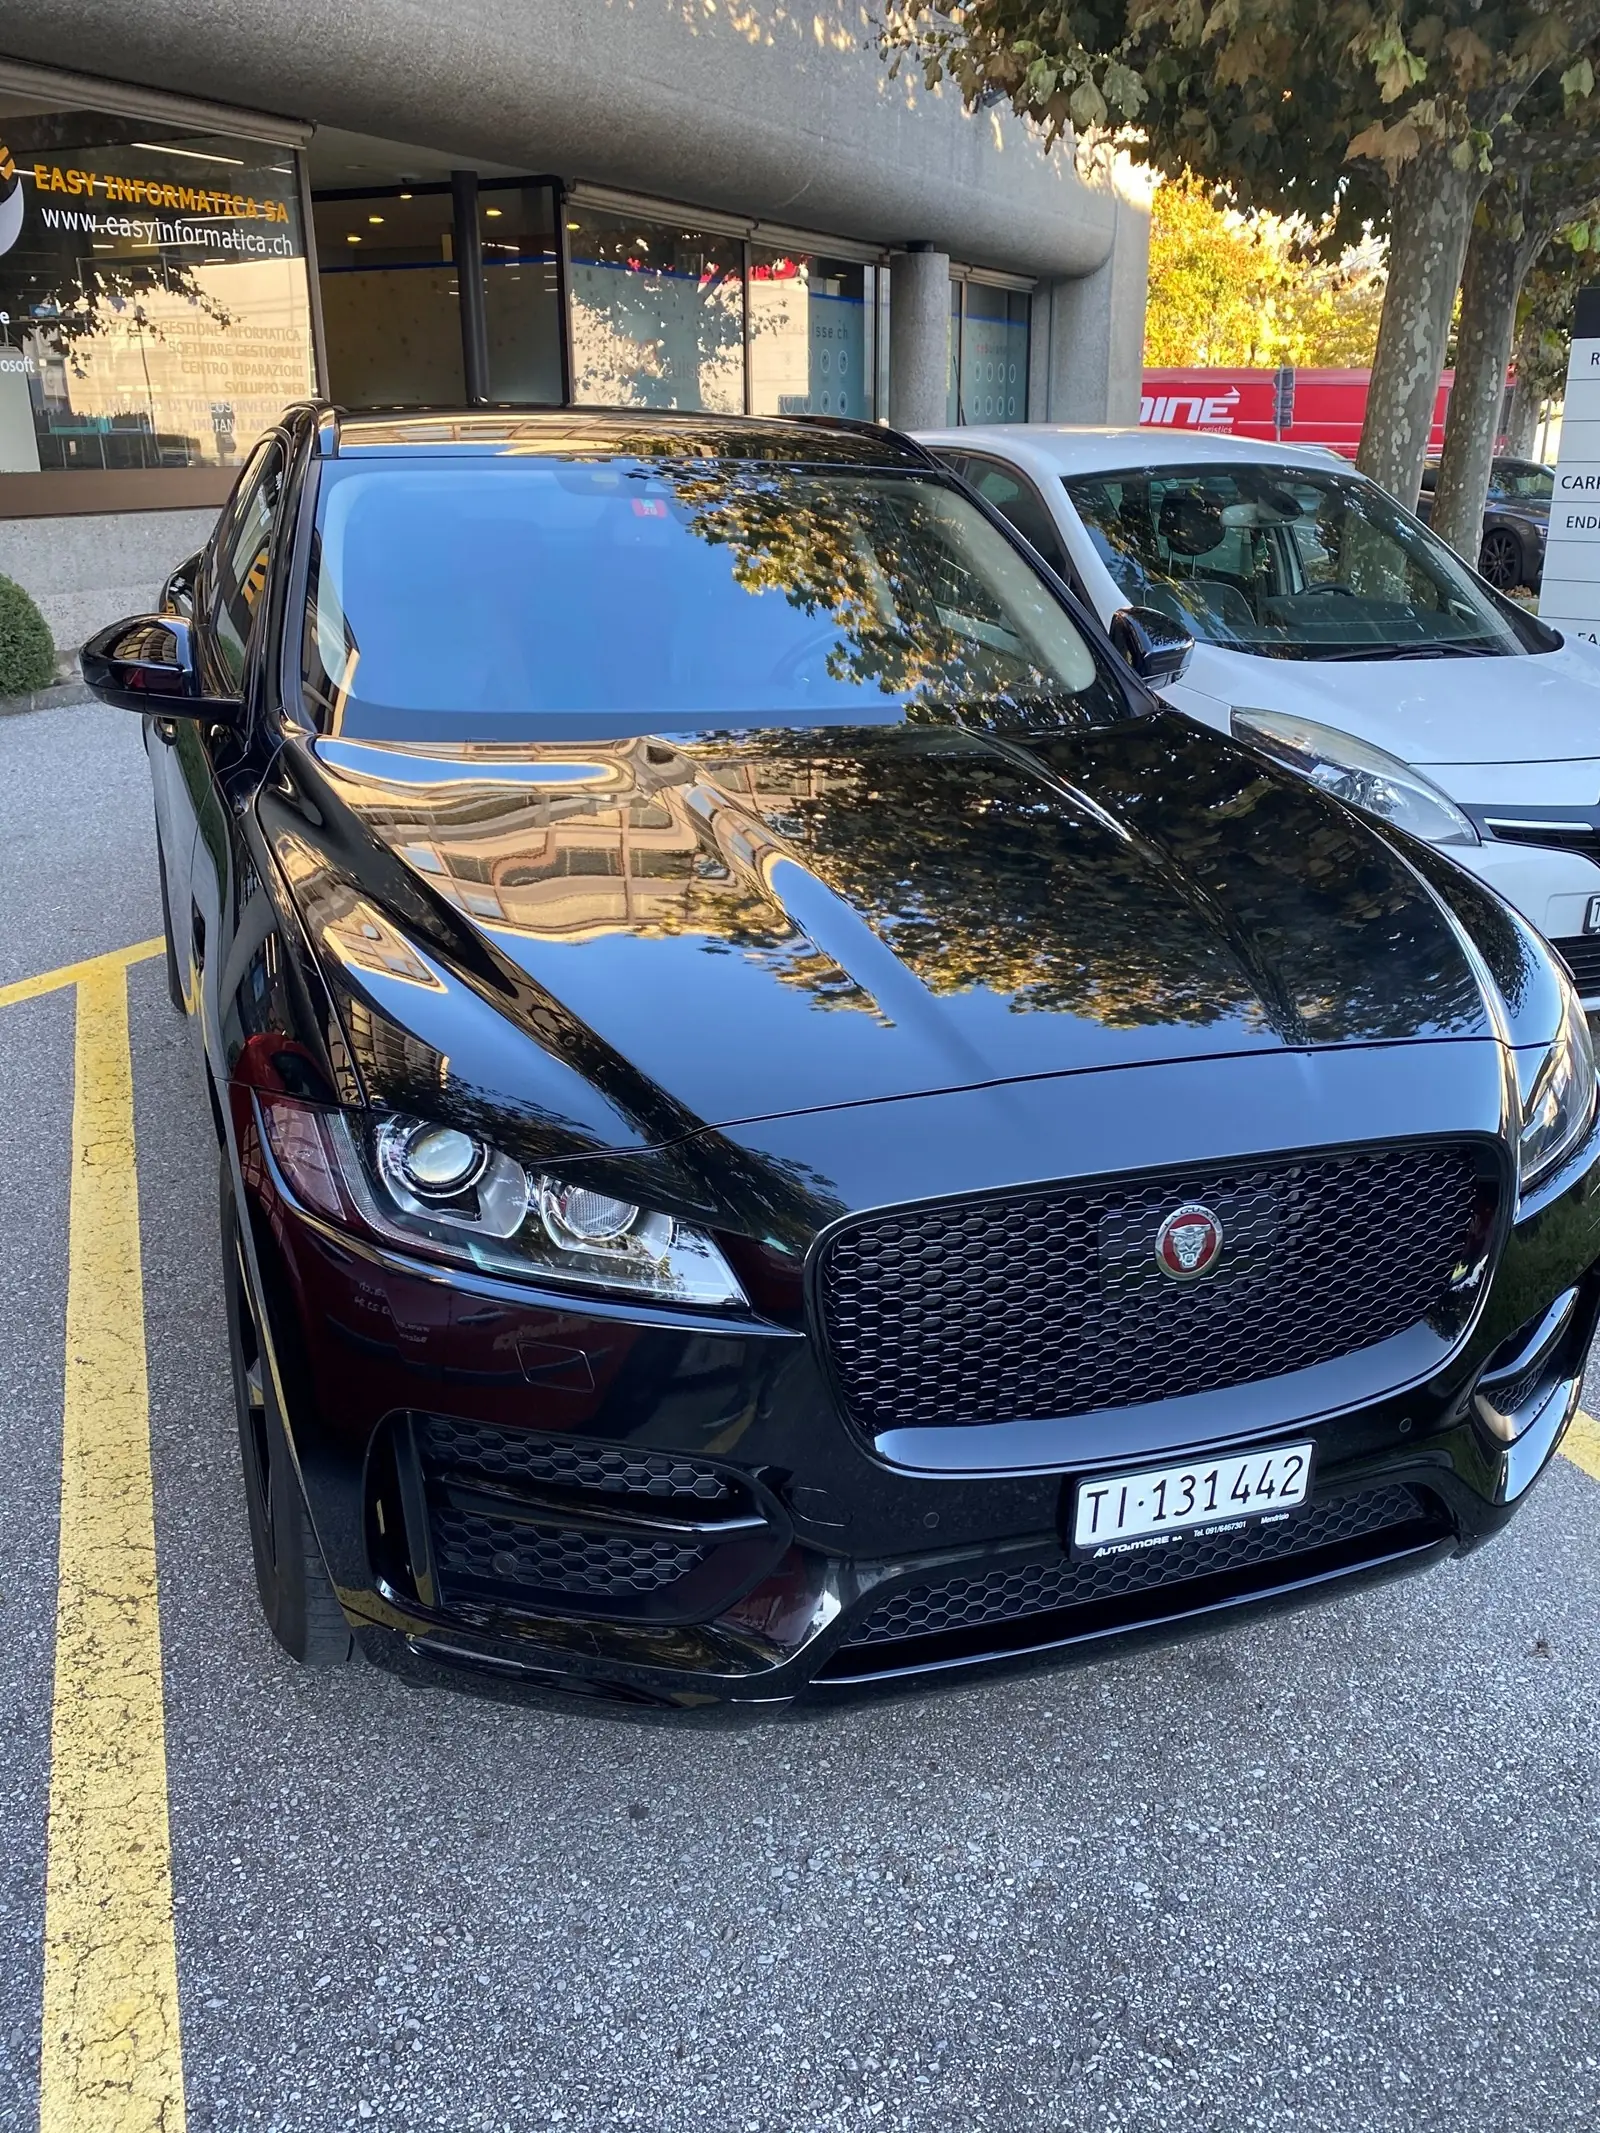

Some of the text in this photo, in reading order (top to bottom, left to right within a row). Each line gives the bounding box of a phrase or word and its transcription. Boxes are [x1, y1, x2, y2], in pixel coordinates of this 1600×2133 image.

[33, 163, 290, 224] EASY INFORMATICA SA
[41, 207, 294, 257] www.easyinformatica.ch
[160, 320, 301, 342] GESTIONE INFORMATICA
[168, 340, 302, 360] SOFTWARE GESTIONALI
[0, 355, 35, 373] osoft
[181, 360, 304, 378] CENTRO RIPARAZIONI
[224, 380, 305, 395] SVILUPPO WEB
